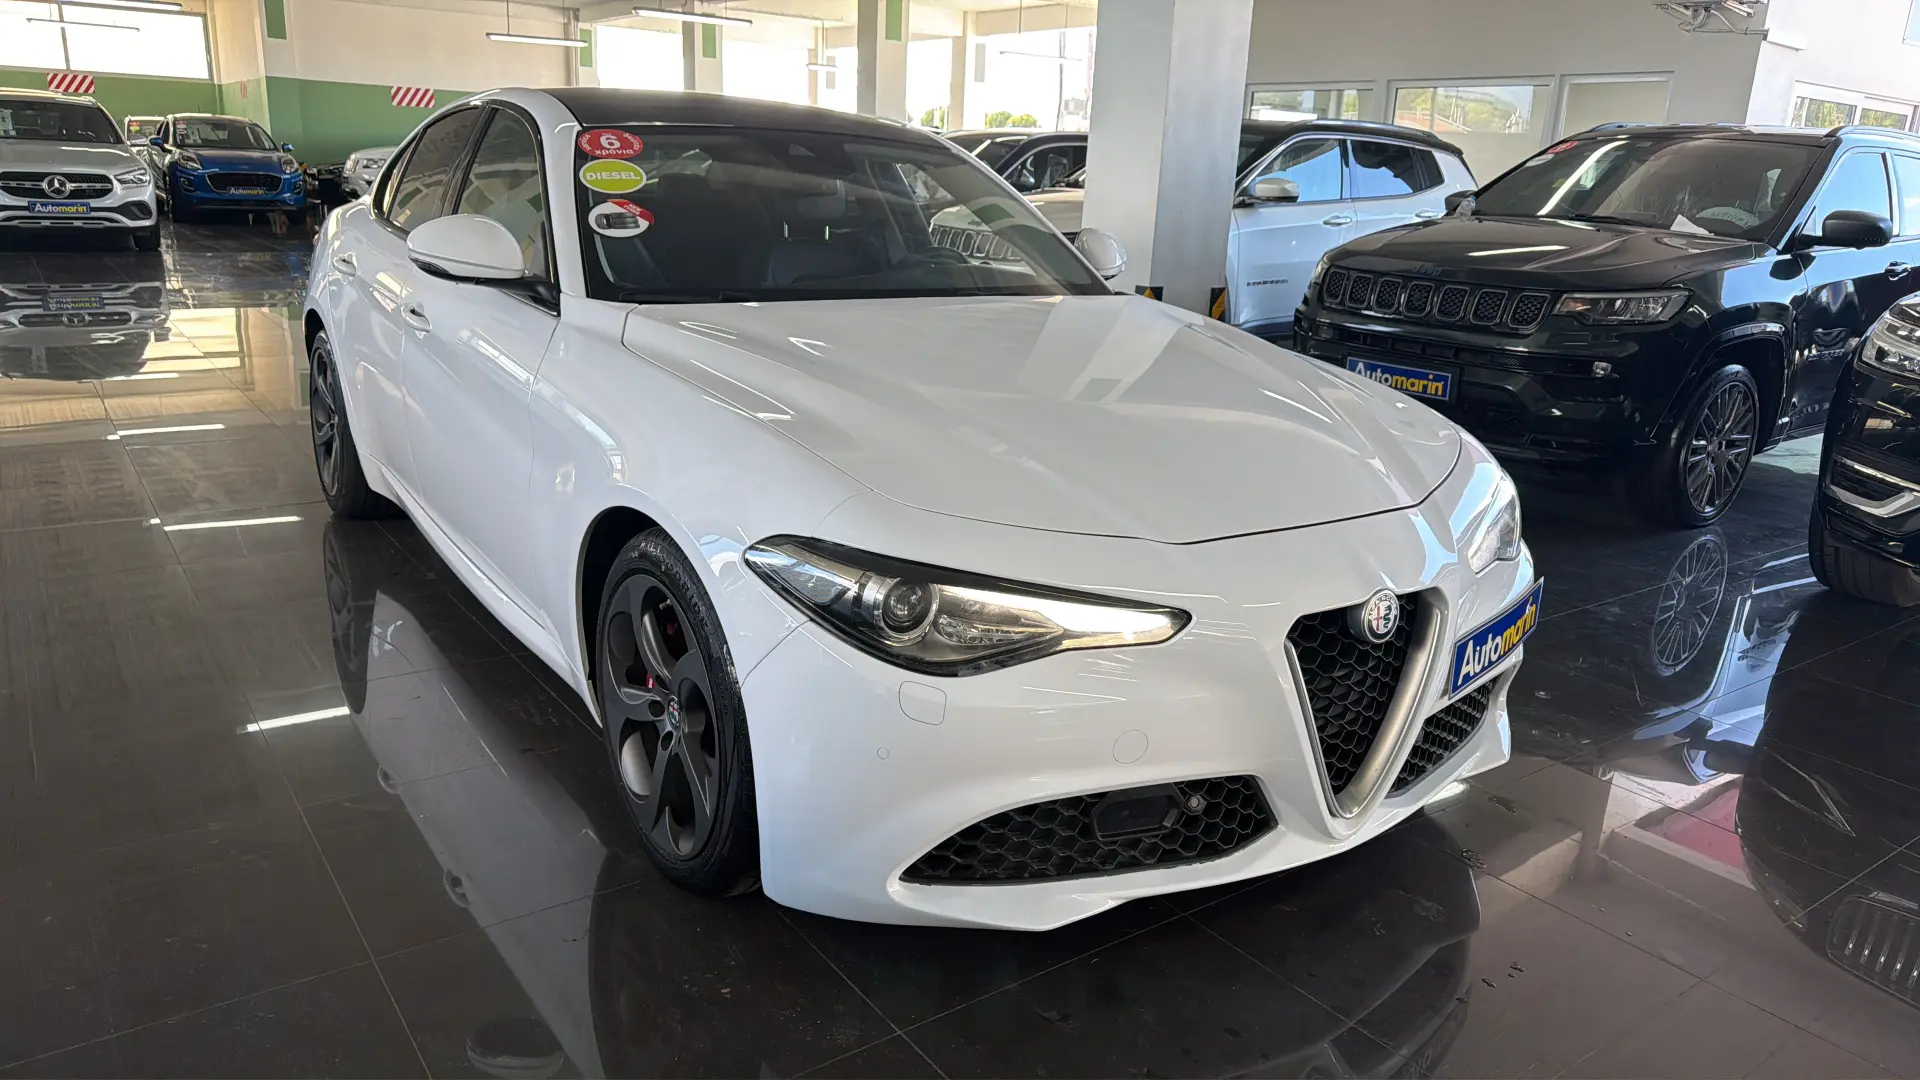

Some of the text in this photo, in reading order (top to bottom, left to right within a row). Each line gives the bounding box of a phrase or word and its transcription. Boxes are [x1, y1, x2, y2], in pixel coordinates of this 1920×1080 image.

[600, 134, 621, 149] 6
[586, 171, 641, 181] DIESEL
[35, 202, 87, 213] Automarin
[1355, 361, 1443, 396] Automarin
[1457, 597, 1537, 687] Automarin
